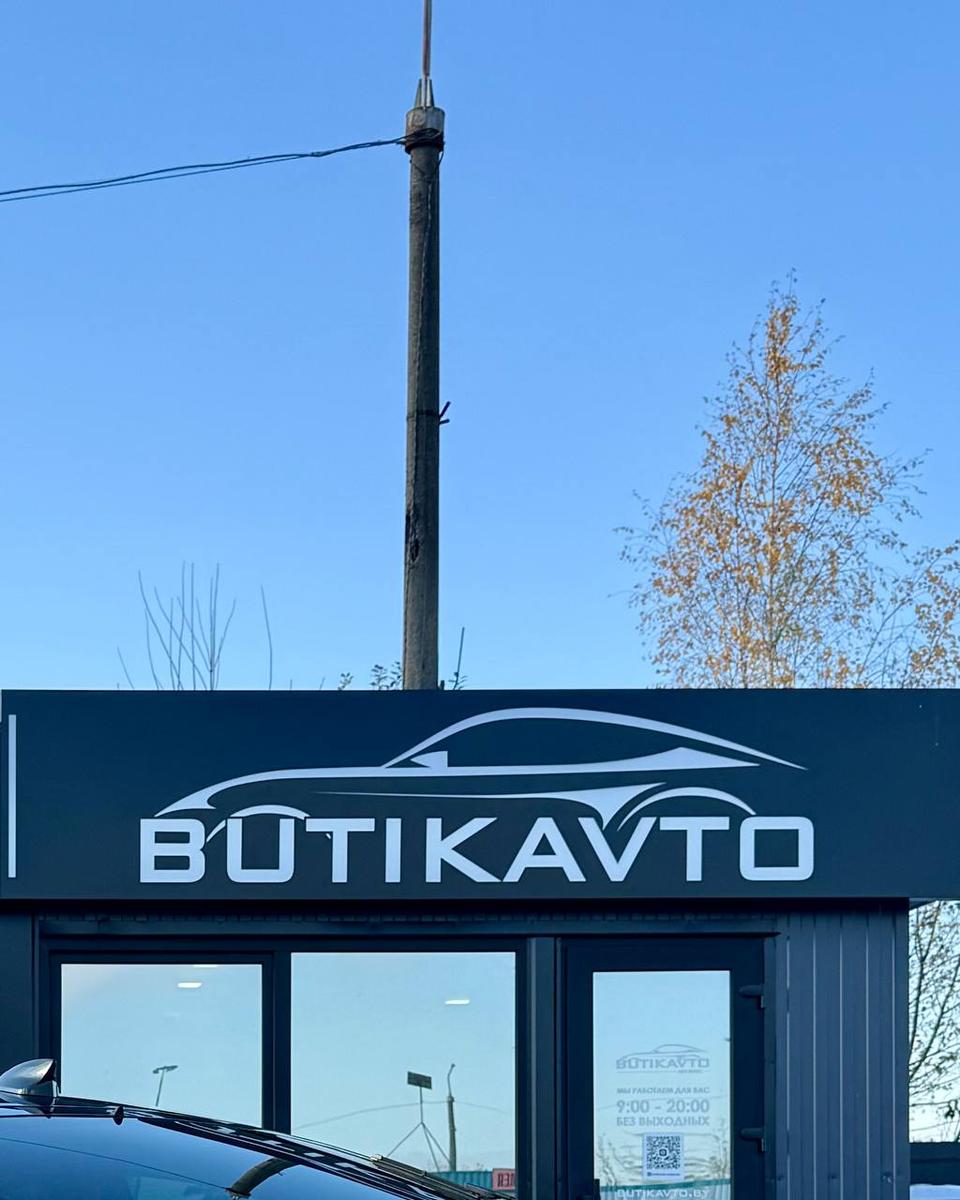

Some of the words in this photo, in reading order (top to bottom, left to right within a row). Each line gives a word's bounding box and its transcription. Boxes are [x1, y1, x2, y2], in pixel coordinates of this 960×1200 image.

[140, 816, 815, 884] BUTIKAVTO
[616, 1058, 709, 1069] BUTIKAVTO
[616, 1100, 650, 1113] 9:00
[666, 1099, 710, 1113] 20:00
[616, 1116, 636, 1127] БЕЗ
[638, 1116, 710, 1127] ВЫХОДНЫХ
[617, 1189, 710, 1198] BUTIKAVTO.BY
